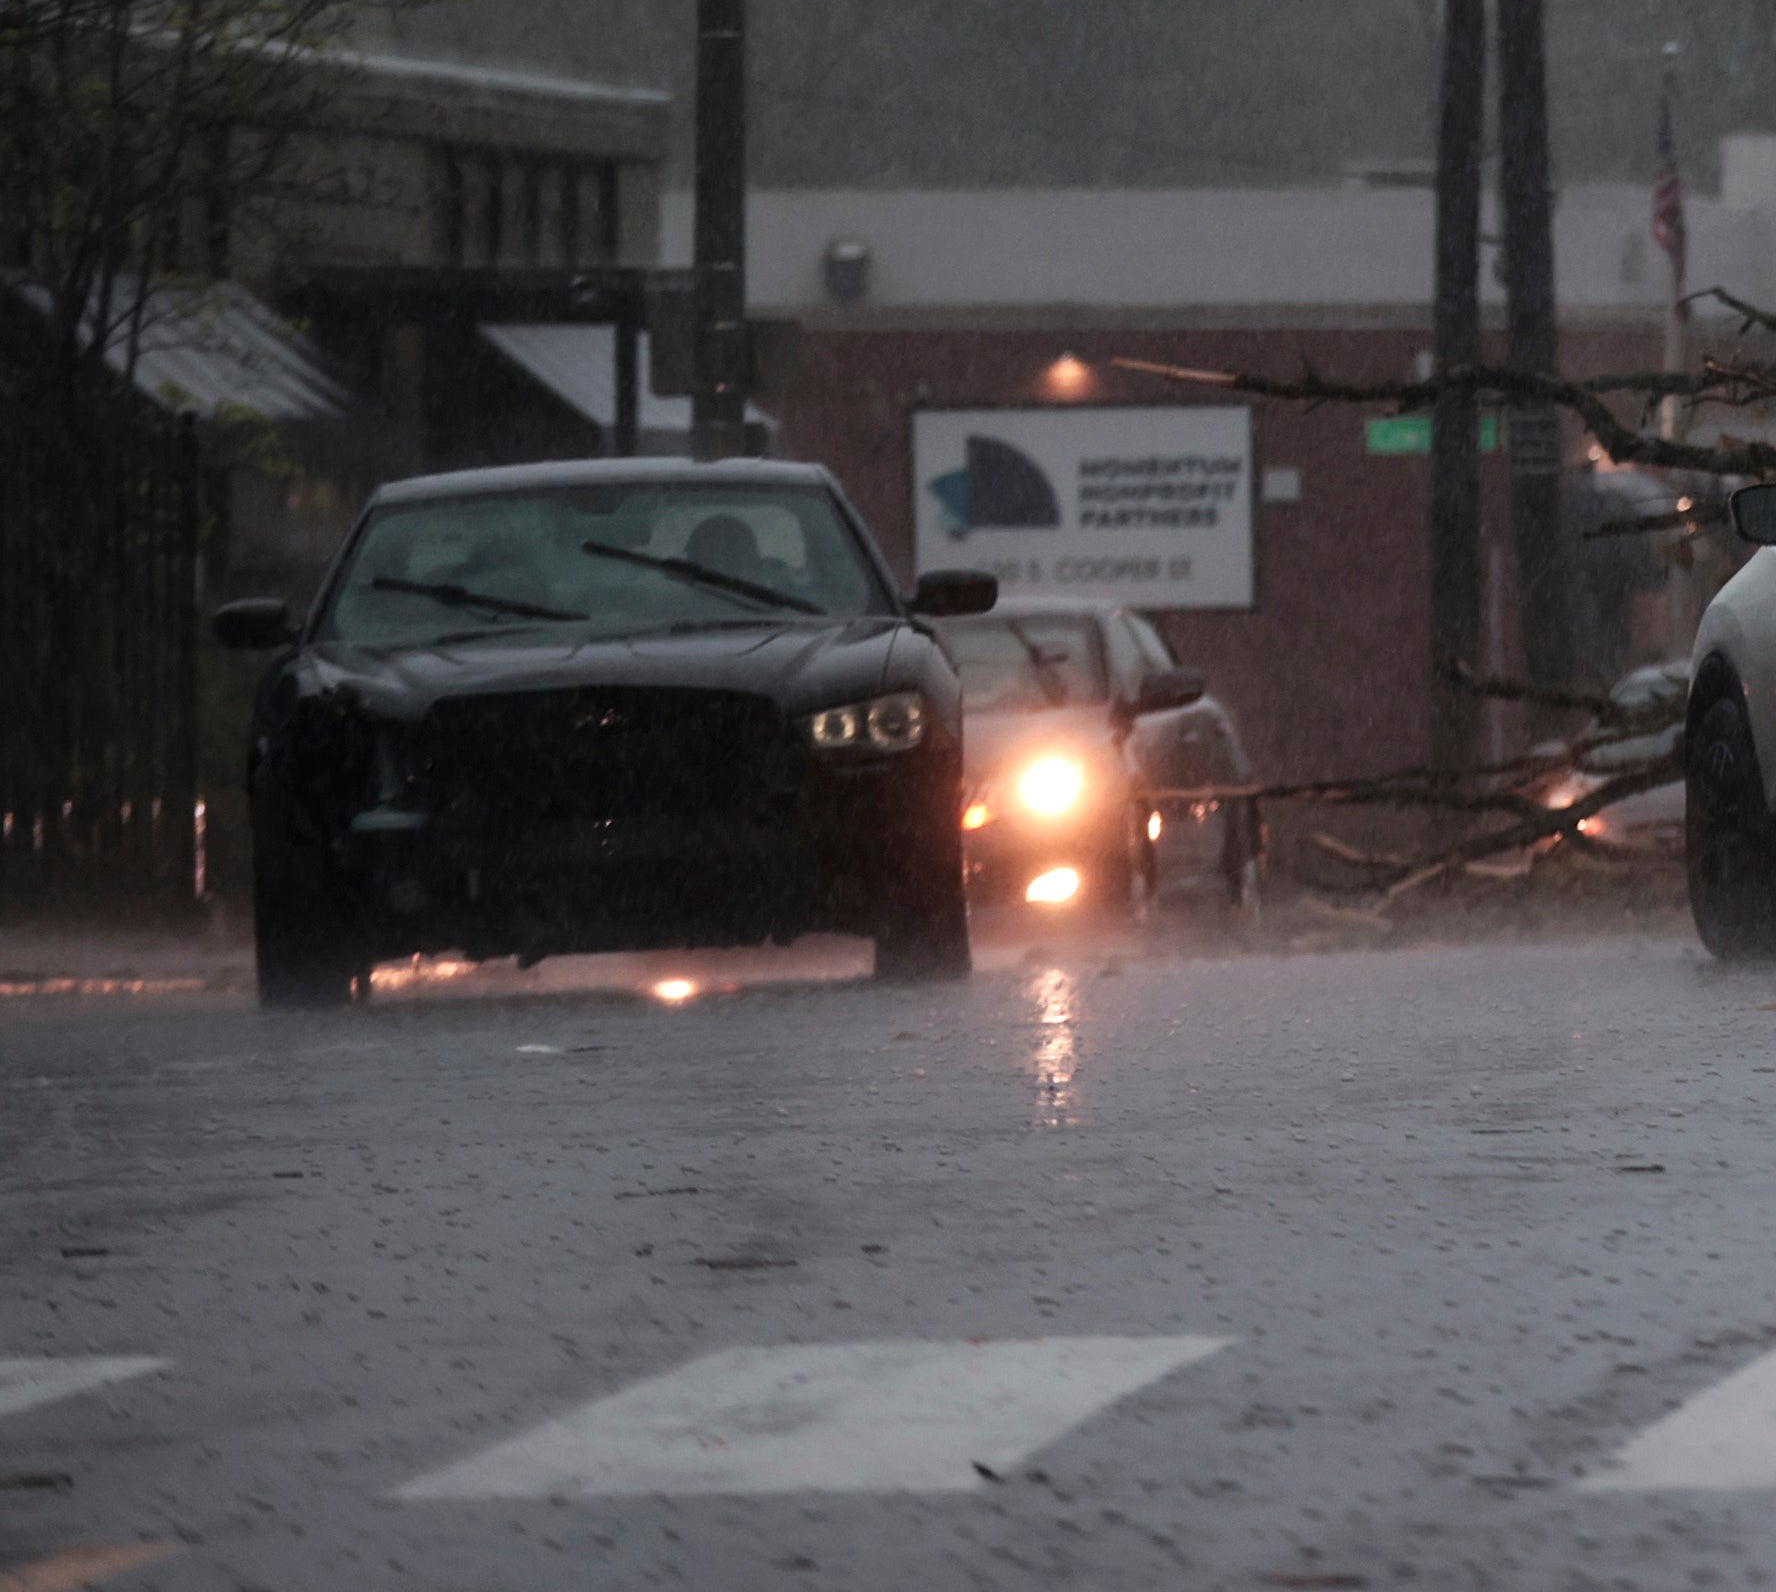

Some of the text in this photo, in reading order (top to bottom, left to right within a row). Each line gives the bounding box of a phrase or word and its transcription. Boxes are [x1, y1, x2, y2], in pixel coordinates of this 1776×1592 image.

[1079, 457, 1241, 476] MOMENTUM
[1079, 482, 1235, 502] NONPROFIT
[1079, 507, 1219, 528] PARTNERS
[1054, 554, 1161, 584] COOPER
